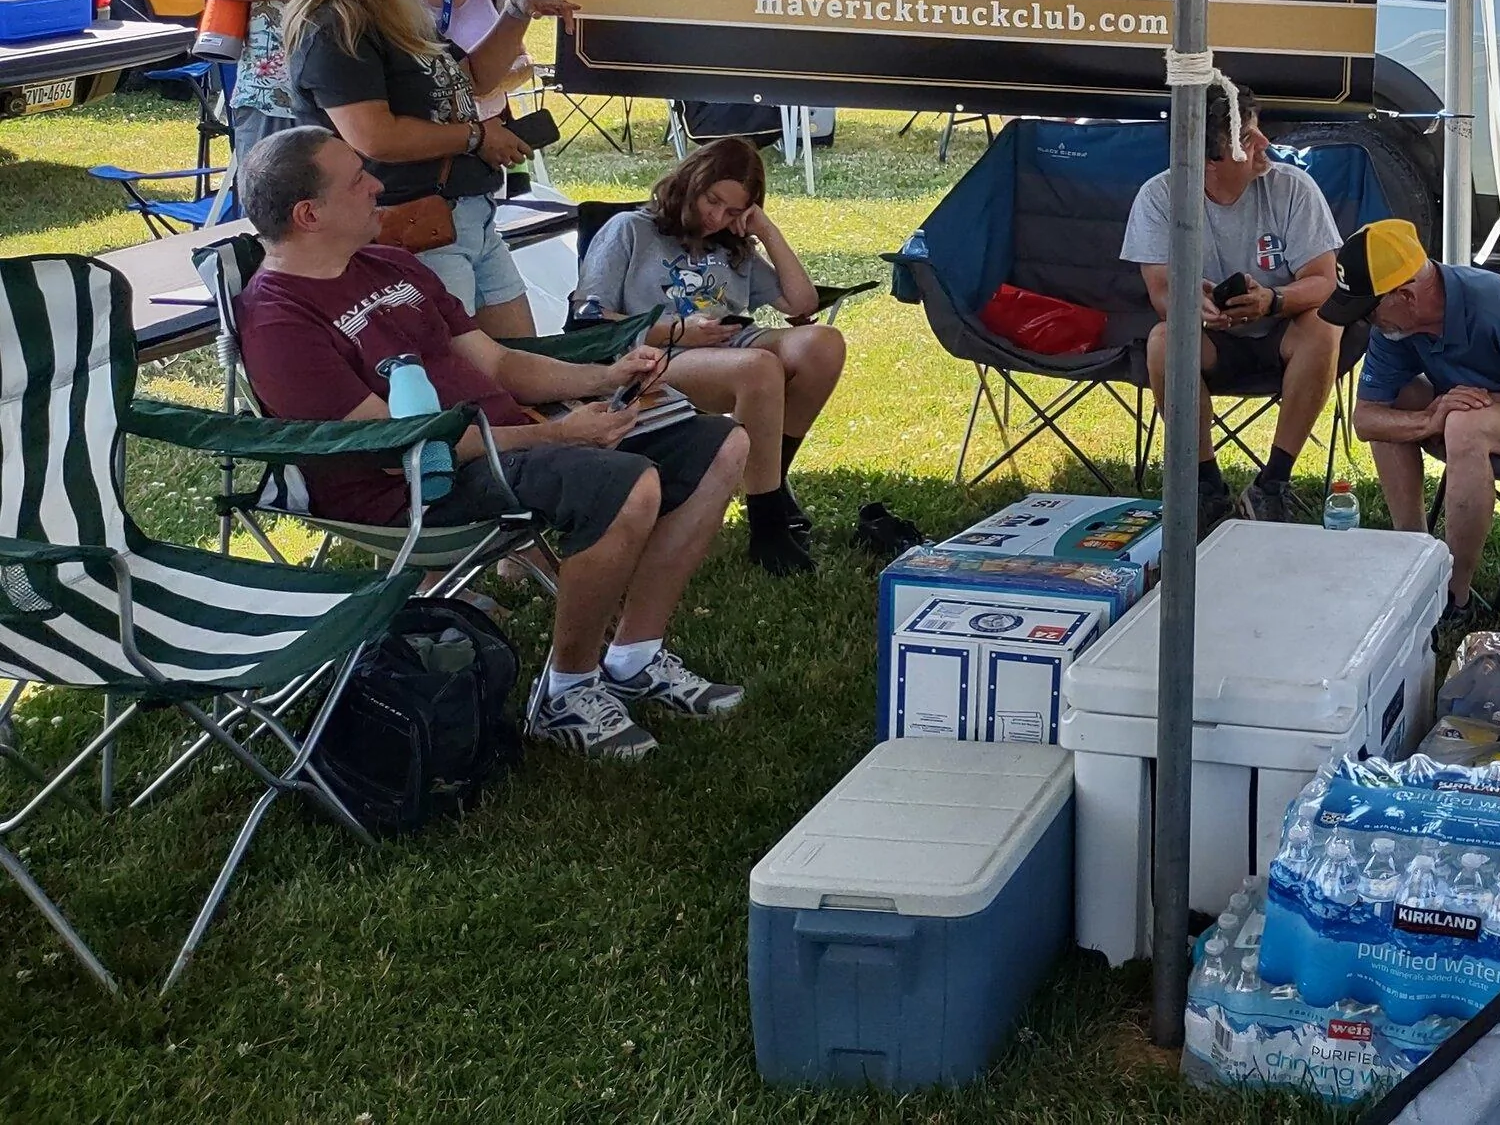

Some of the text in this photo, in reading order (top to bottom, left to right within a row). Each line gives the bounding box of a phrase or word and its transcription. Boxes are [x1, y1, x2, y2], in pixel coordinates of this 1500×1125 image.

[1394, 788, 1474, 807] urified
[1398, 908, 1477, 931] KIRKLAND
[1357, 942, 1437, 972] purified
[1427, 974, 1452, 982] added
[1331, 1024, 1371, 1037] weis
[1265, 1050, 1355, 1086] drinking
